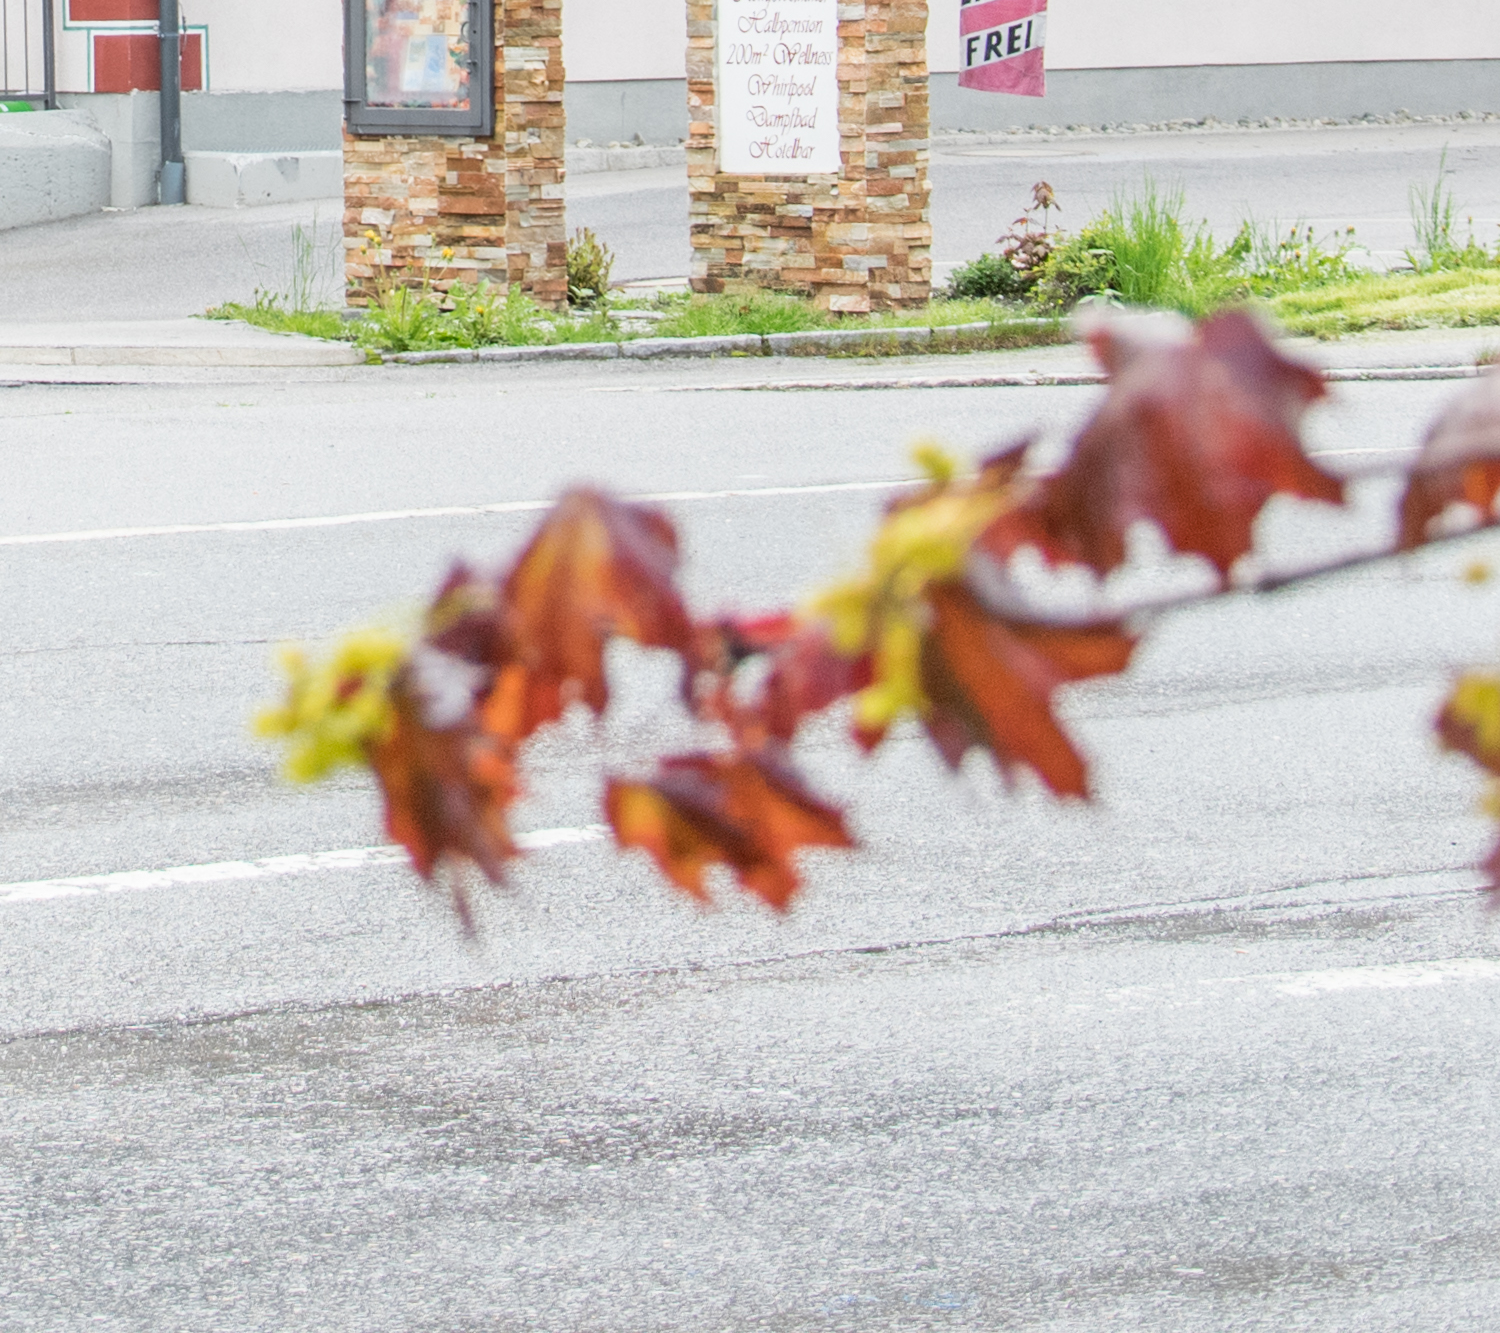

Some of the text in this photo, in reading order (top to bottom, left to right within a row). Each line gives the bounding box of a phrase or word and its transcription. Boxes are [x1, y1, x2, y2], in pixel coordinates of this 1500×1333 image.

[738, 8, 824, 41] Halbpension
[772, 42, 834, 66] Wellness
[965, 19, 1033, 67] FREI
[747, 73, 818, 106] Whirlpool
[745, 105, 819, 136] Dampfbad
[748, 134, 817, 159] Hotelbar
